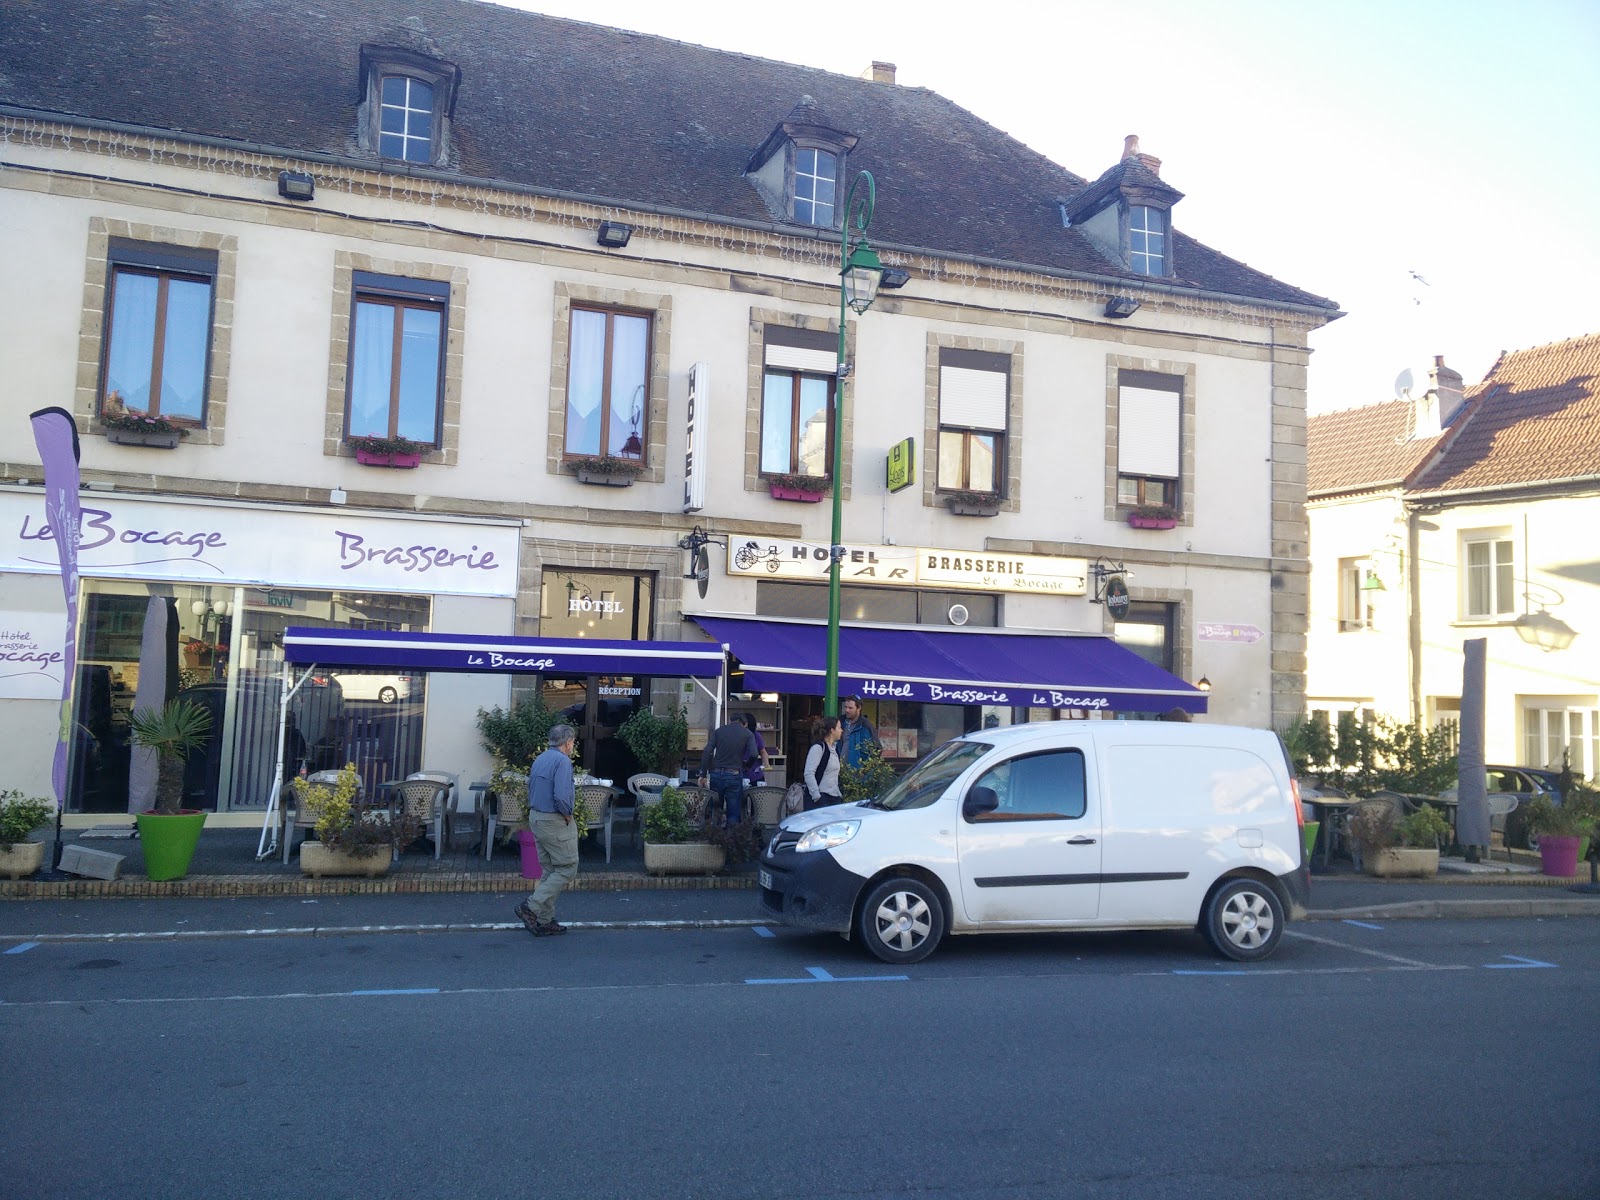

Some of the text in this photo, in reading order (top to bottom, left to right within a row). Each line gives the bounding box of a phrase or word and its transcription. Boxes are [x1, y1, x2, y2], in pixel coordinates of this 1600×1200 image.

[684, 369, 696, 505] HOTEL
[19, 514, 56, 541] Le
[78, 507, 227, 557] Bocage
[334, 530, 499, 572] Brasserie
[792, 546, 879, 564] HOEL
[928, 555, 1024, 575] BRASSERIE
[1013, 578, 1063, 590] Bocage
[569, 597, 625, 613] HÔTEL
[0, 630, 31, 641] Hôtel
[467, 652, 556, 670] Le Bocage
[598, 685, 642, 696] RÉCEPTION
[862, 680, 1110, 709] Hôtel Brasserie Le Bocage
